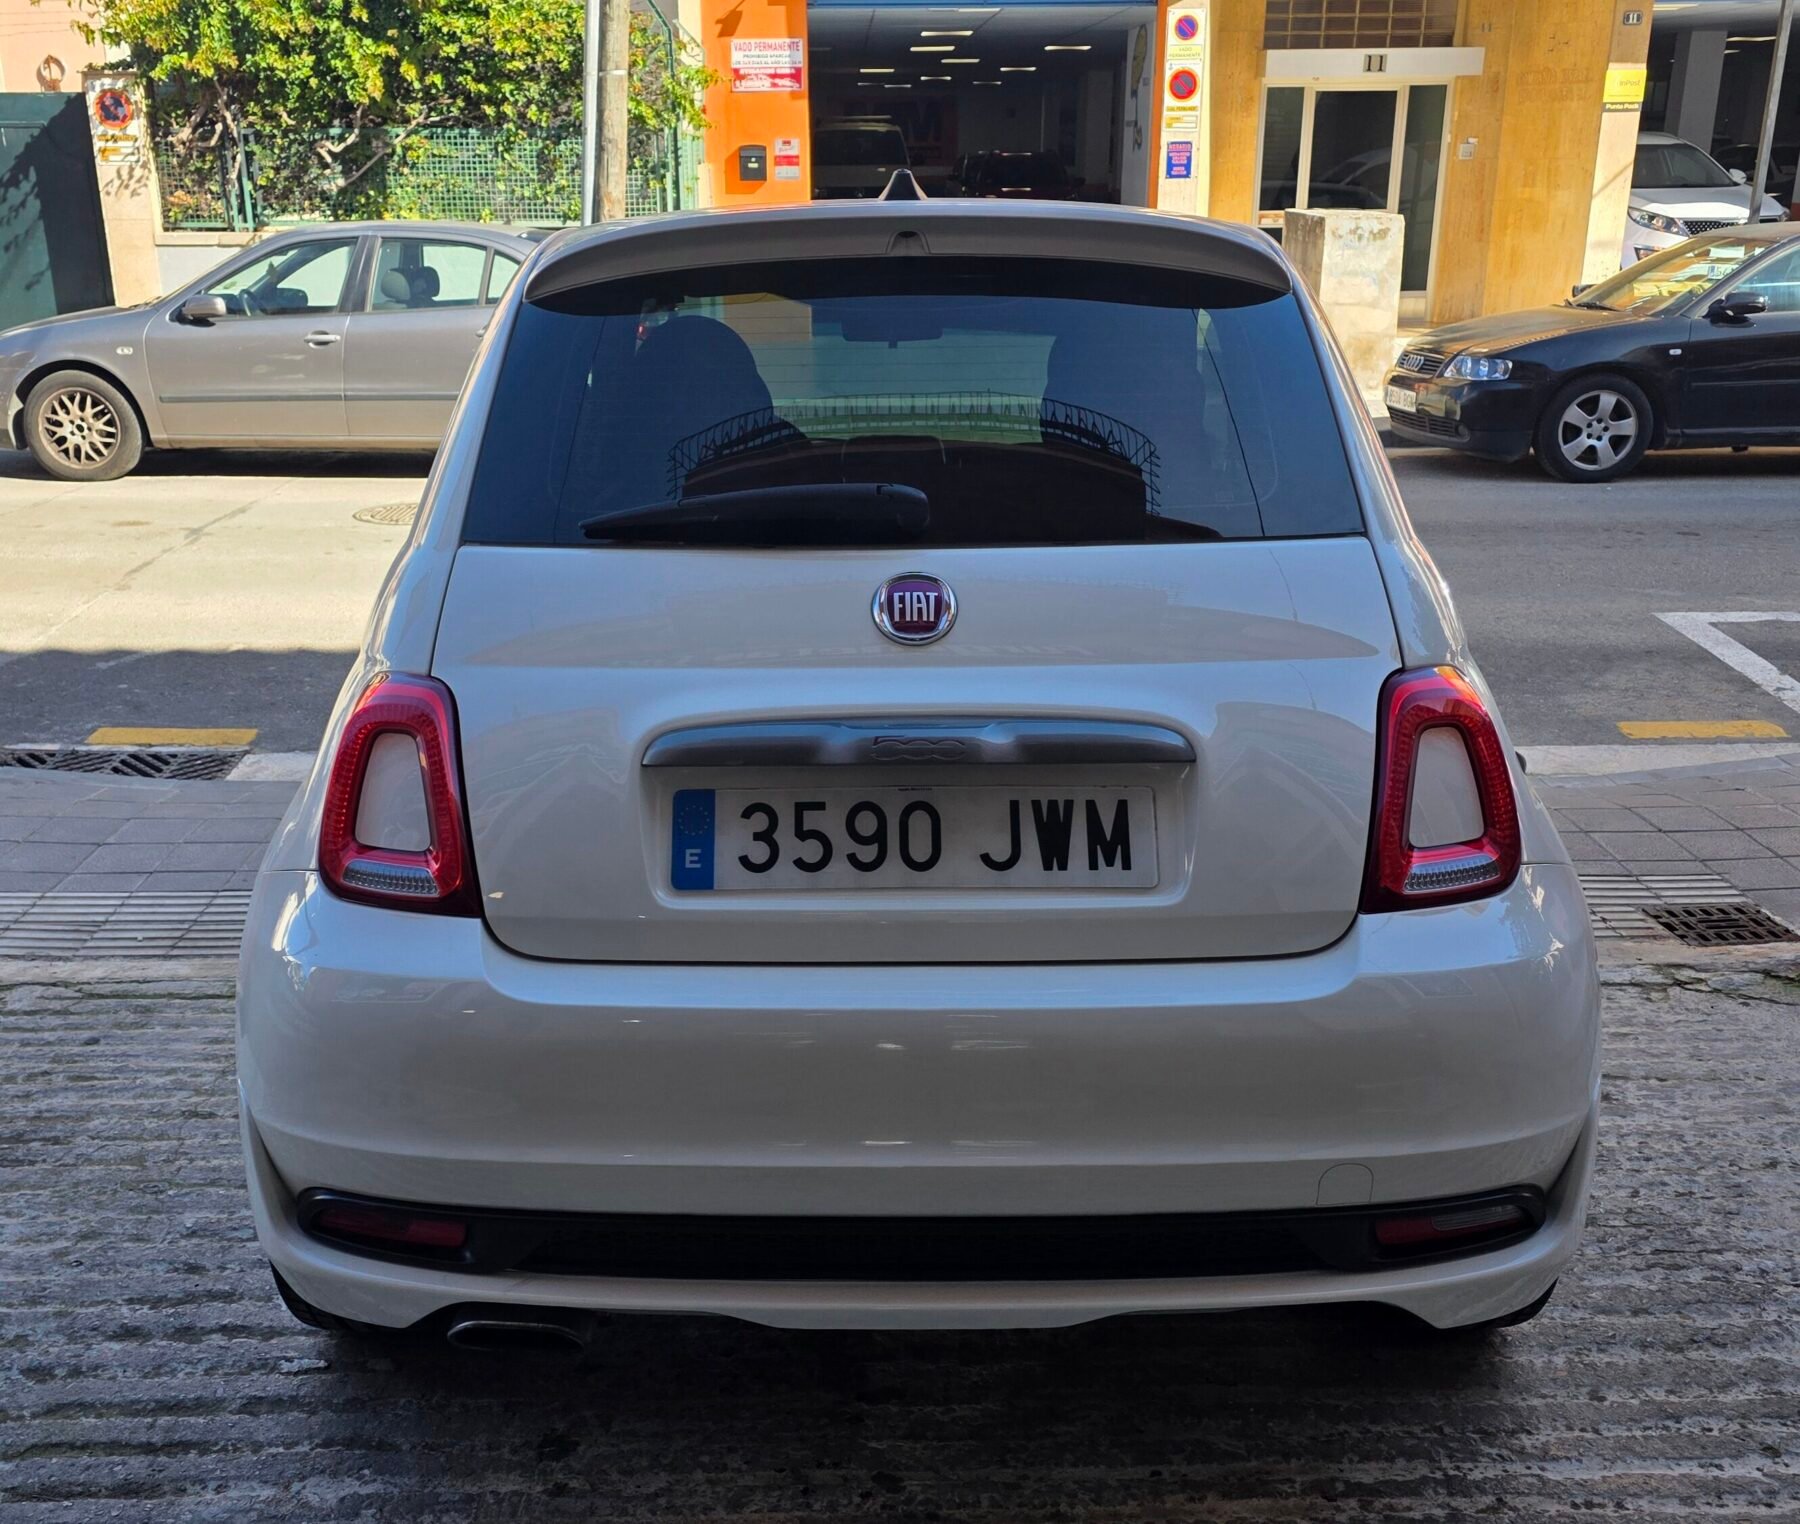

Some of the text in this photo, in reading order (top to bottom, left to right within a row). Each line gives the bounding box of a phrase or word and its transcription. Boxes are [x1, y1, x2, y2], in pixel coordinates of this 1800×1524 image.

[733, 41, 801, 52] VADO PERMANENTE
[893, 591, 938, 622] FIAT
[871, 735, 966, 761] 500
[737, 799, 1133, 874] 3590 JWM
[685, 848, 701, 869] E
